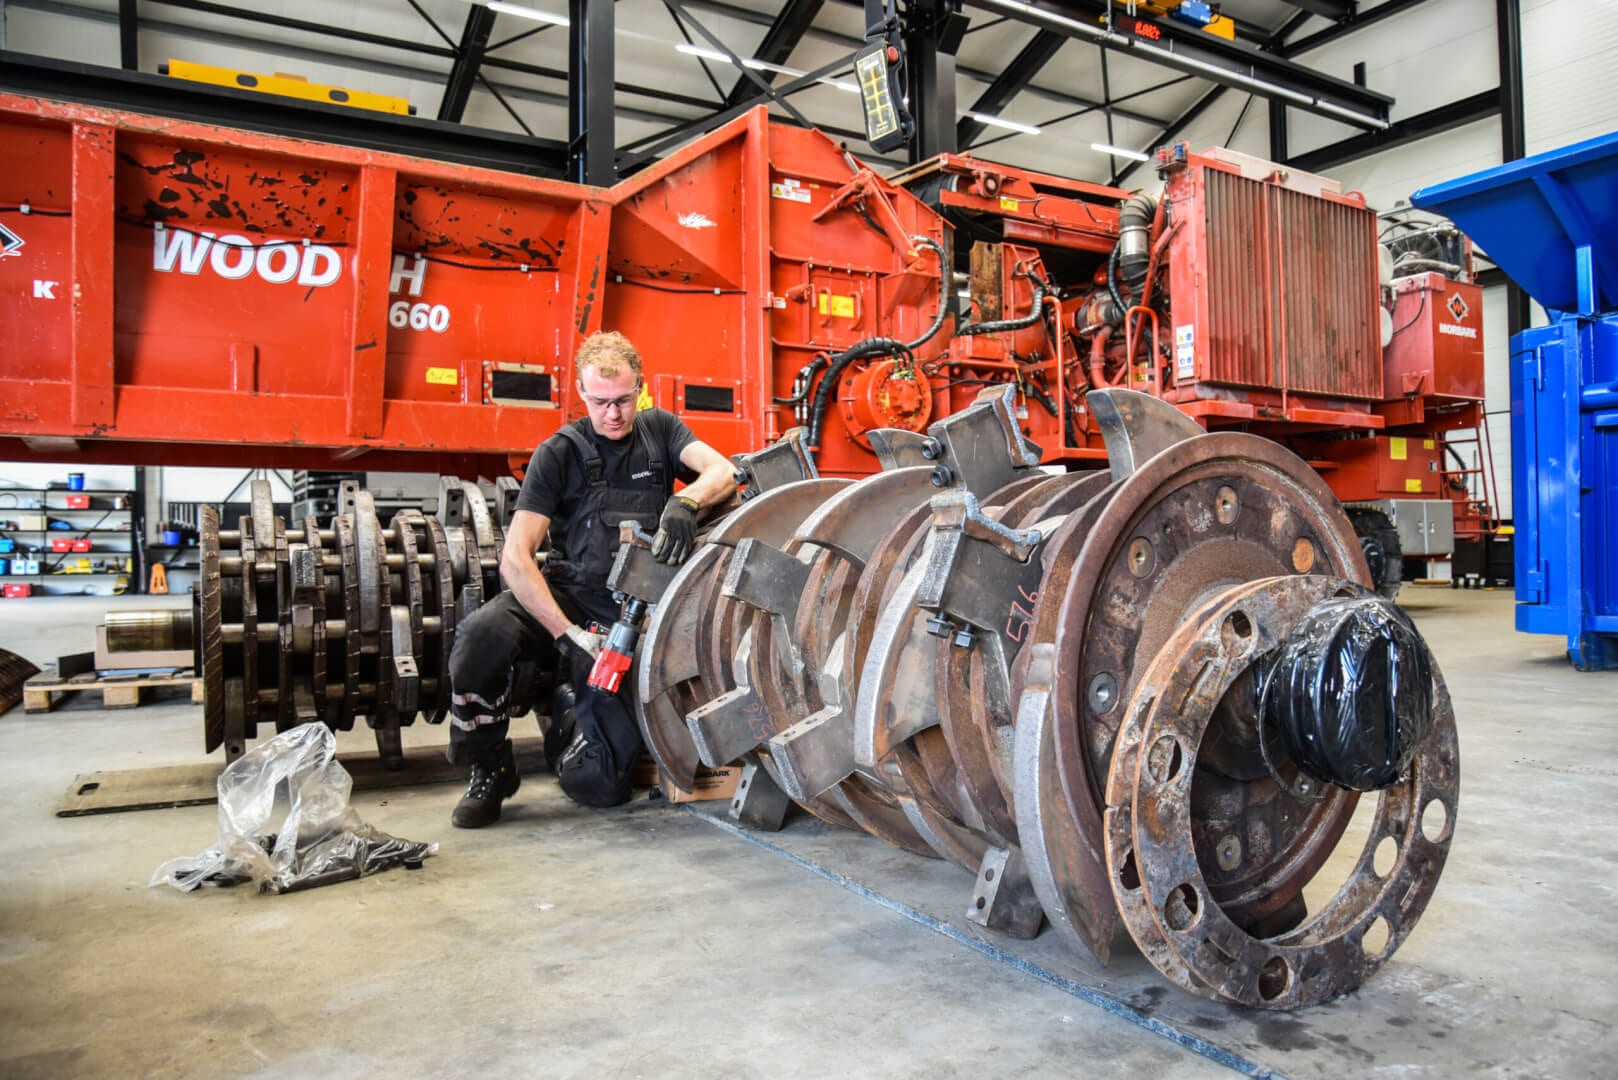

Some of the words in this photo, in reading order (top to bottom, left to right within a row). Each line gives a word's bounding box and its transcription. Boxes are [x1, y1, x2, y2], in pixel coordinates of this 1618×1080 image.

[152, 227, 342, 287] WOOD
[33, 279, 57, 299] K
[388, 301, 451, 333] 660
